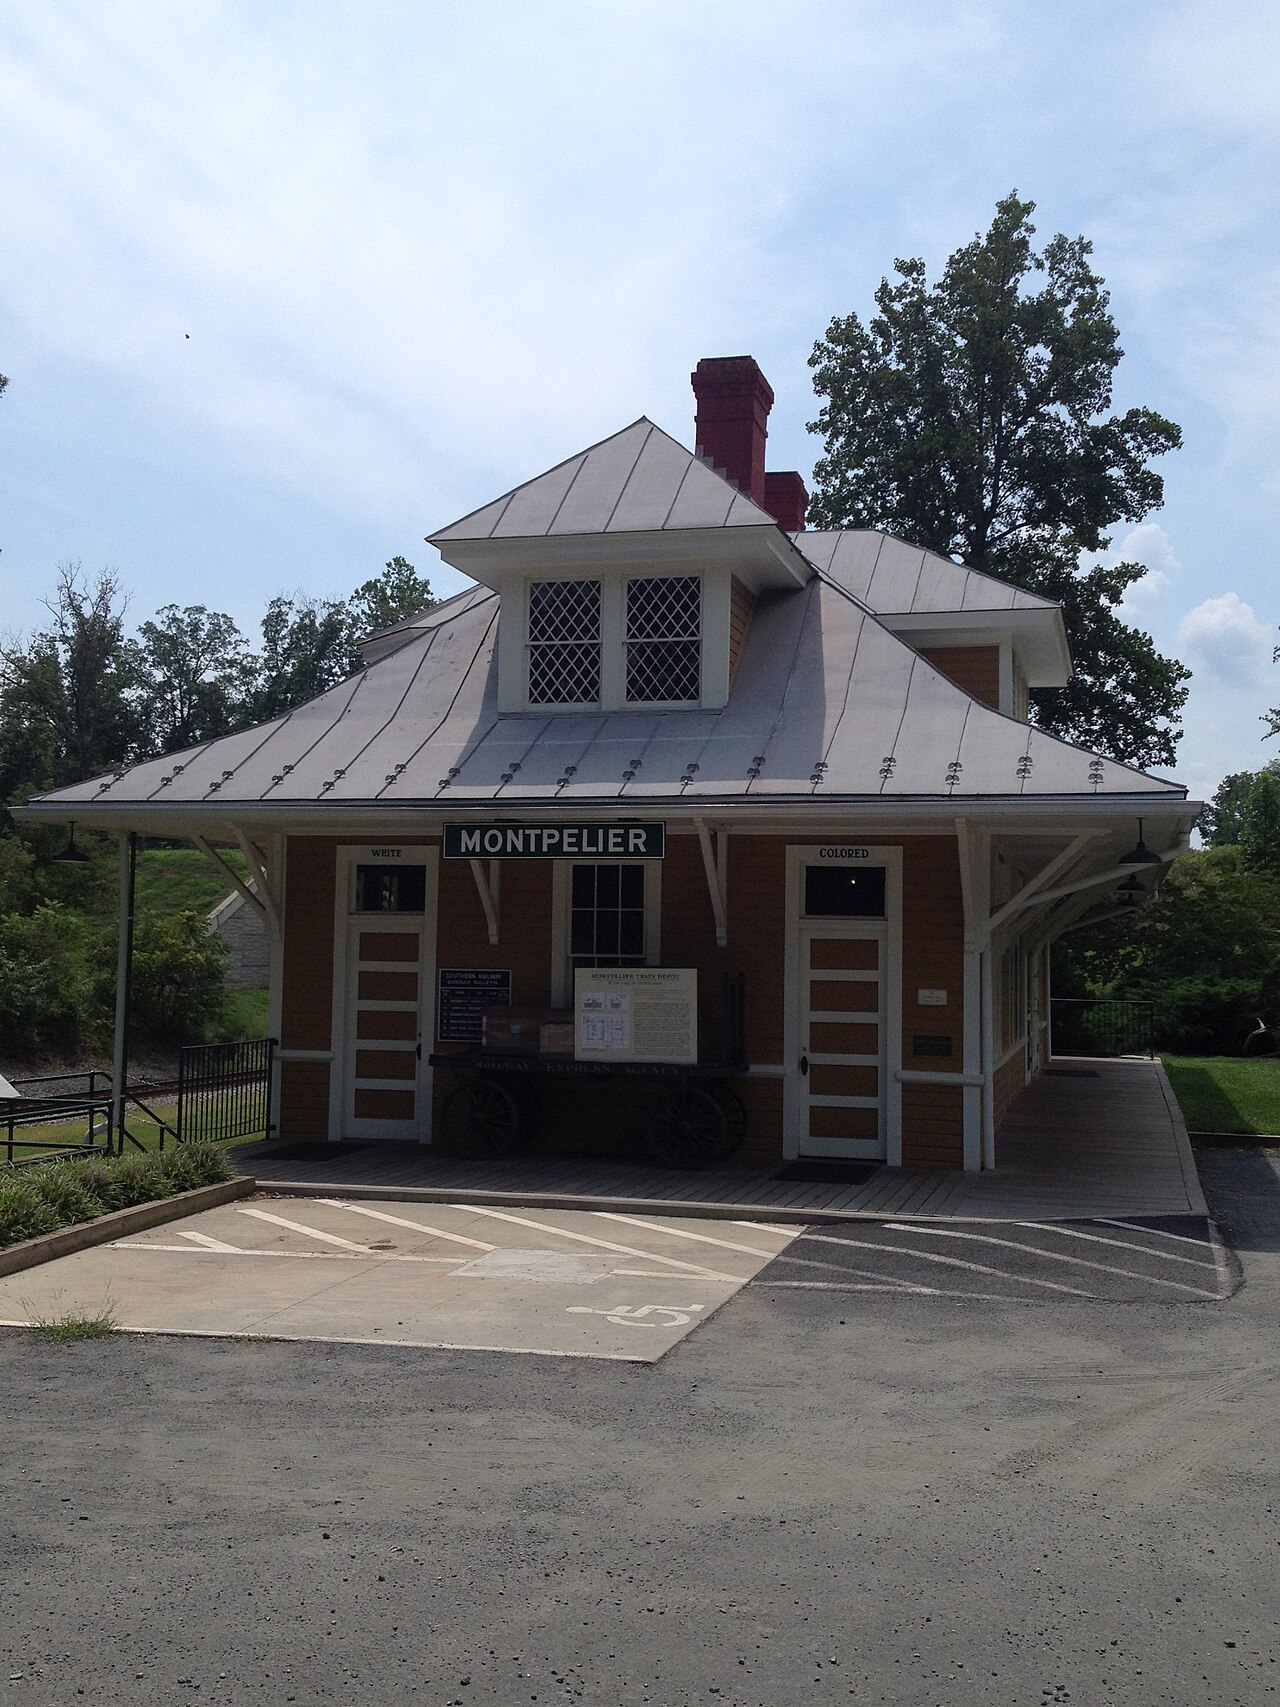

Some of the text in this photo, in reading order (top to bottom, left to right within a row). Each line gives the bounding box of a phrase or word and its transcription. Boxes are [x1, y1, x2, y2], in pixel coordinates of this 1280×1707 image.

[460, 829, 647, 853] MONTPELIER
[371, 848, 402, 857] WHITE
[819, 848, 869, 858] COLORED
[474, 1060, 679, 1076] RAILWAY EXPRESS AGENCY
